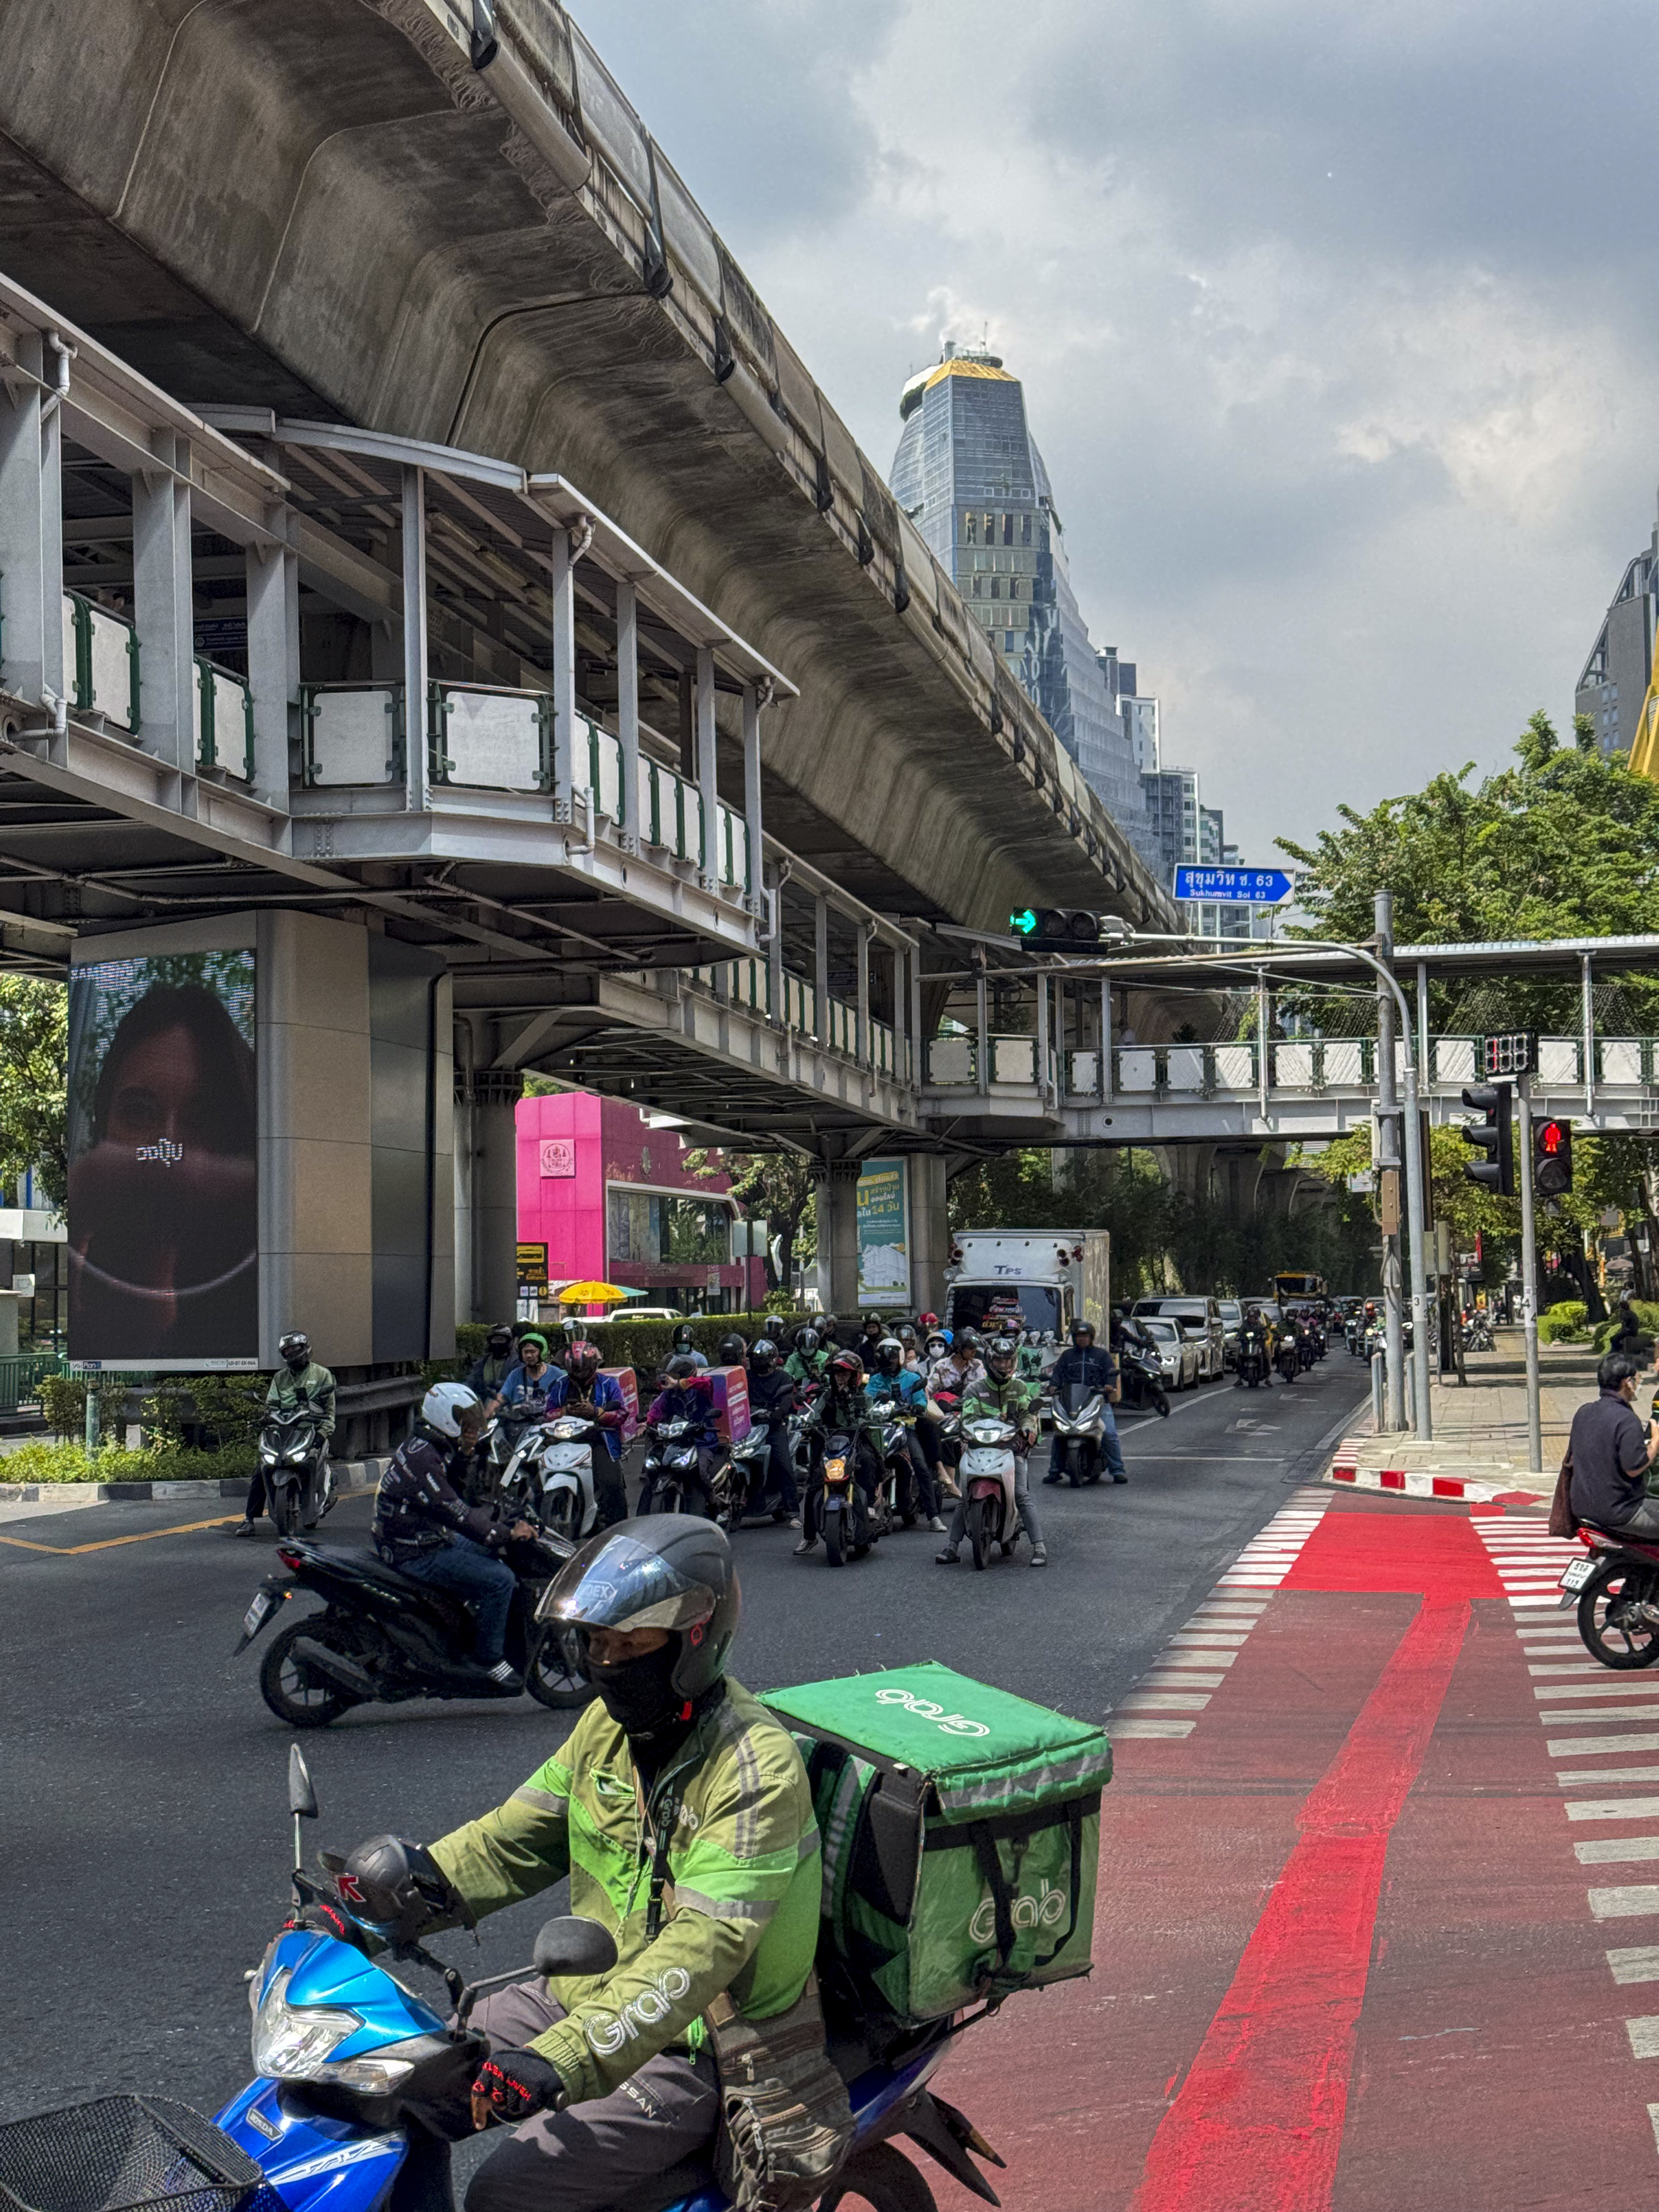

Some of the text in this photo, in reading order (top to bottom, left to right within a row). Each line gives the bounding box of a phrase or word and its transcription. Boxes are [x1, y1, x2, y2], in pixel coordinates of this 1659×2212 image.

[1185, 870, 1235, 888] สุขุมวิท
[1256, 875, 1273, 887] 63
[1189, 889, 1266, 899] Sukhumvit Soi 63
[1414, 1297, 1420, 1306] 3
[1523, 1298, 1531, 1309] 4
[874, 1689, 990, 1737] Grab
[661, 1798, 674, 1827] Grab
[969, 1878, 1066, 1943] Gab
[619, 2081, 657, 2119] SSAN
[249, 2112, 273, 2137] HONDA
